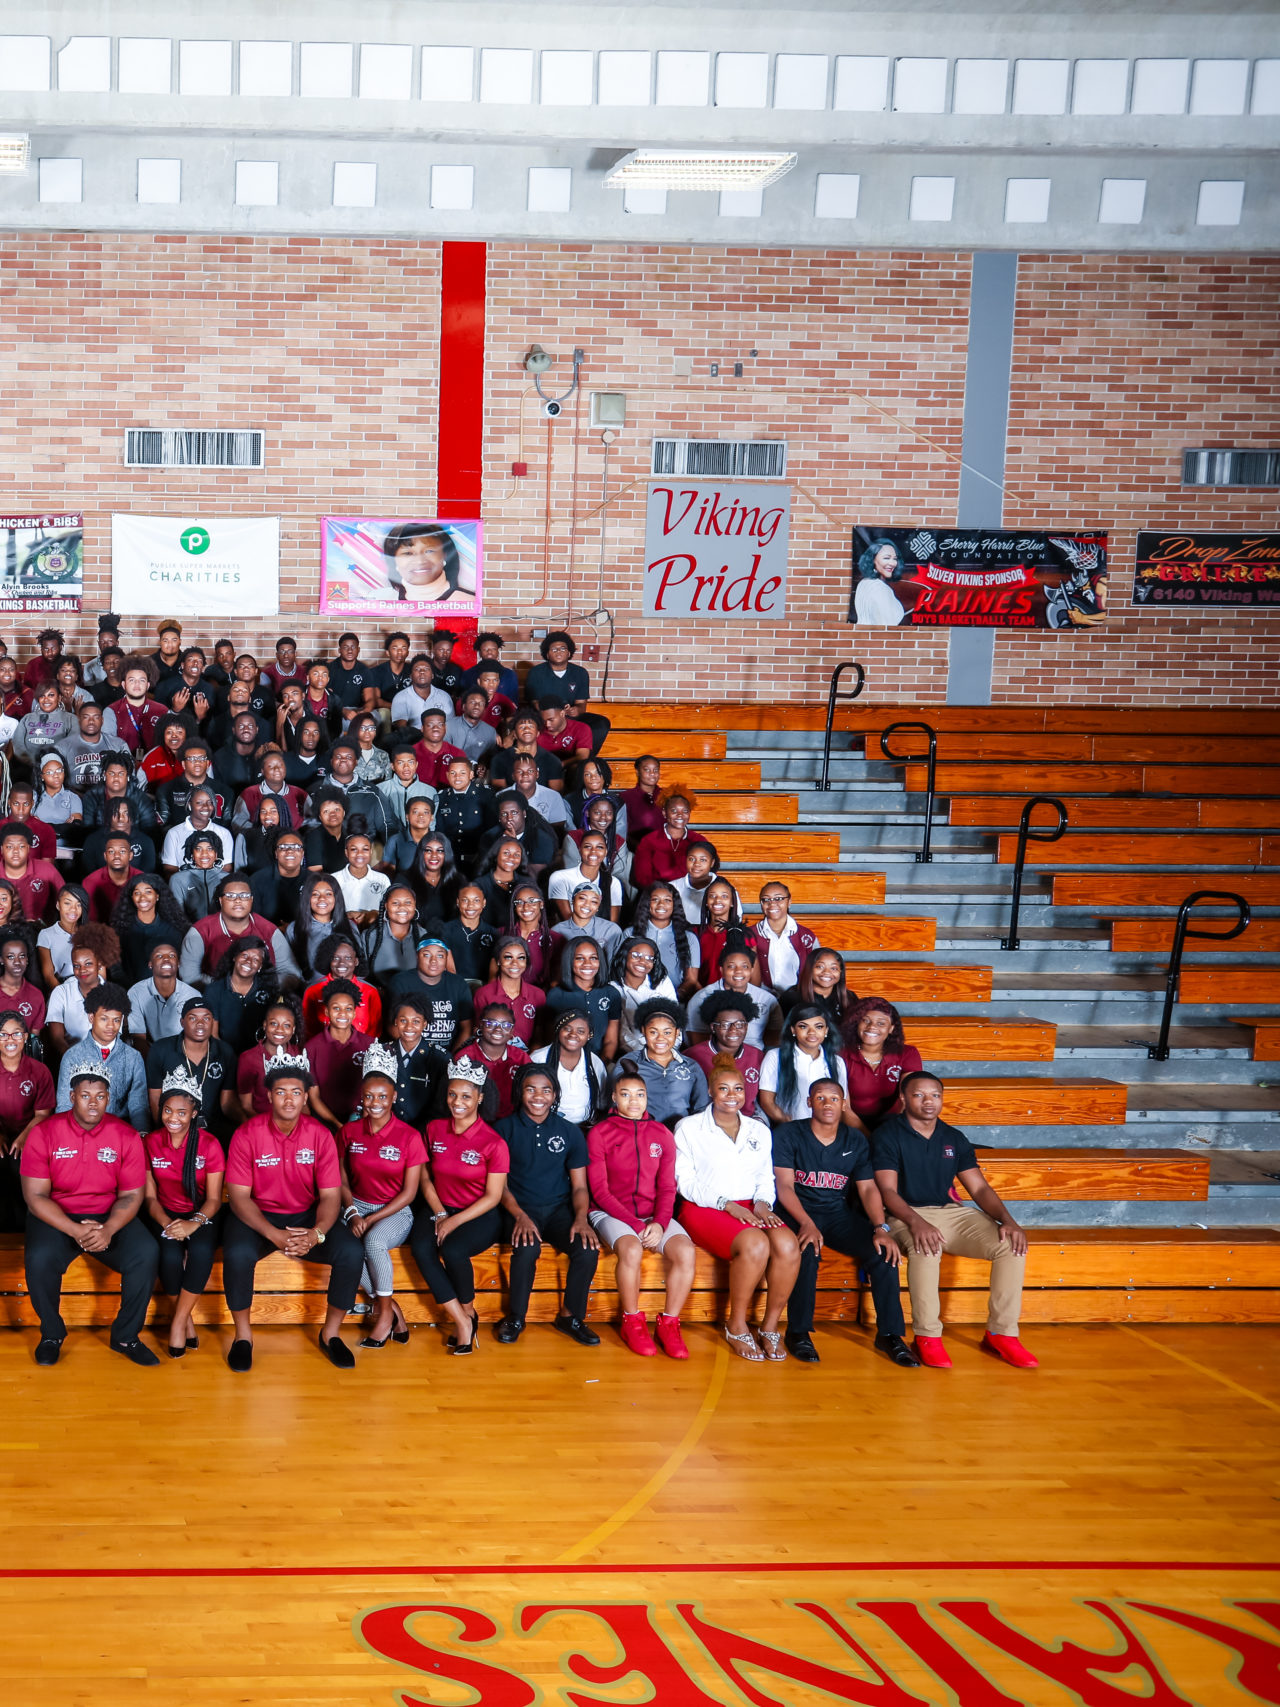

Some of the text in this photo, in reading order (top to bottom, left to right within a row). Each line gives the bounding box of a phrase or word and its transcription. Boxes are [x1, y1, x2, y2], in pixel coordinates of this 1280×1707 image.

[42, 517, 50, 527] &
[53, 516, 79, 527] RIBS
[652, 488, 785, 548] Viking
[938, 538, 1046, 554] Sherry Harris Blue
[1149, 536, 1230, 569] Drop
[940, 552, 1045, 560] FOUNDATION
[149, 571, 241, 583] CHARITIES
[927, 566, 1025, 587] SILVER VIKING SPONSOR
[1158, 566, 1268, 582] GRILLE
[648, 554, 782, 612] Pride
[913, 589, 1036, 614] RAINES
[1152, 588, 1196, 601] 6140
[1200, 589, 1253, 603] Viking
[26, 600, 78, 611] BASKETBALL
[326, 601, 474, 611] Supports Raines Basketball
[911, 613, 937, 624] BOYS
[1007, 615, 1036, 626] TEAM
[75, 753, 104, 765] RAIN
[431, 1000, 453, 1013] NGS
[423, 1020, 456, 1032] UEENS
